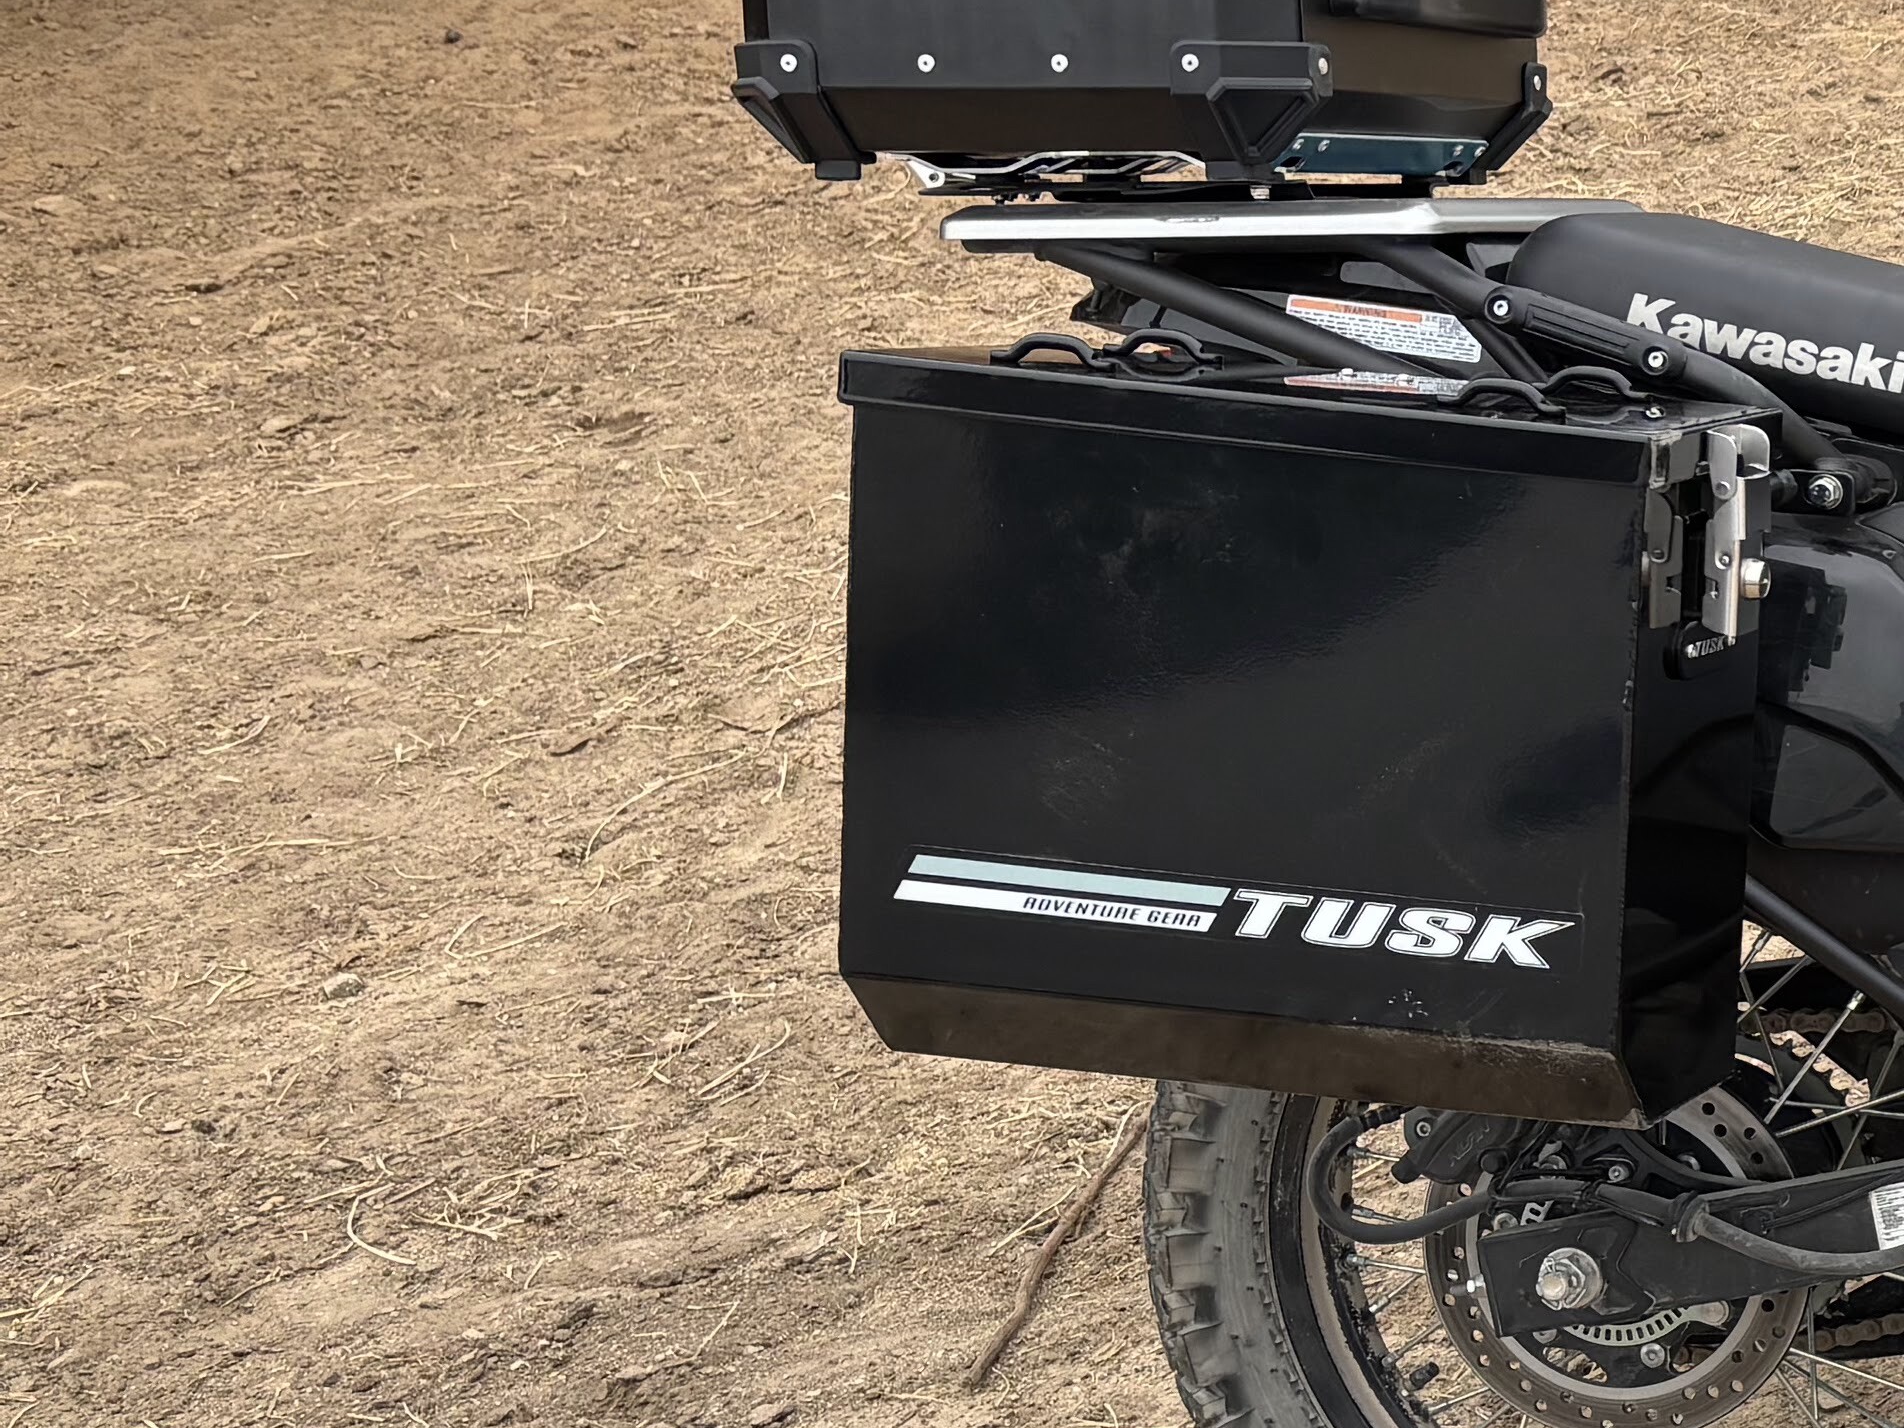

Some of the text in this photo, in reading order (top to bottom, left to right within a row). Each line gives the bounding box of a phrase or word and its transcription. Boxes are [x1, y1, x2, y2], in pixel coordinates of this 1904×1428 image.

[1023, 896, 1201, 927] ADVENTURE GEAR
[1231, 887, 1576, 970] TUSK
